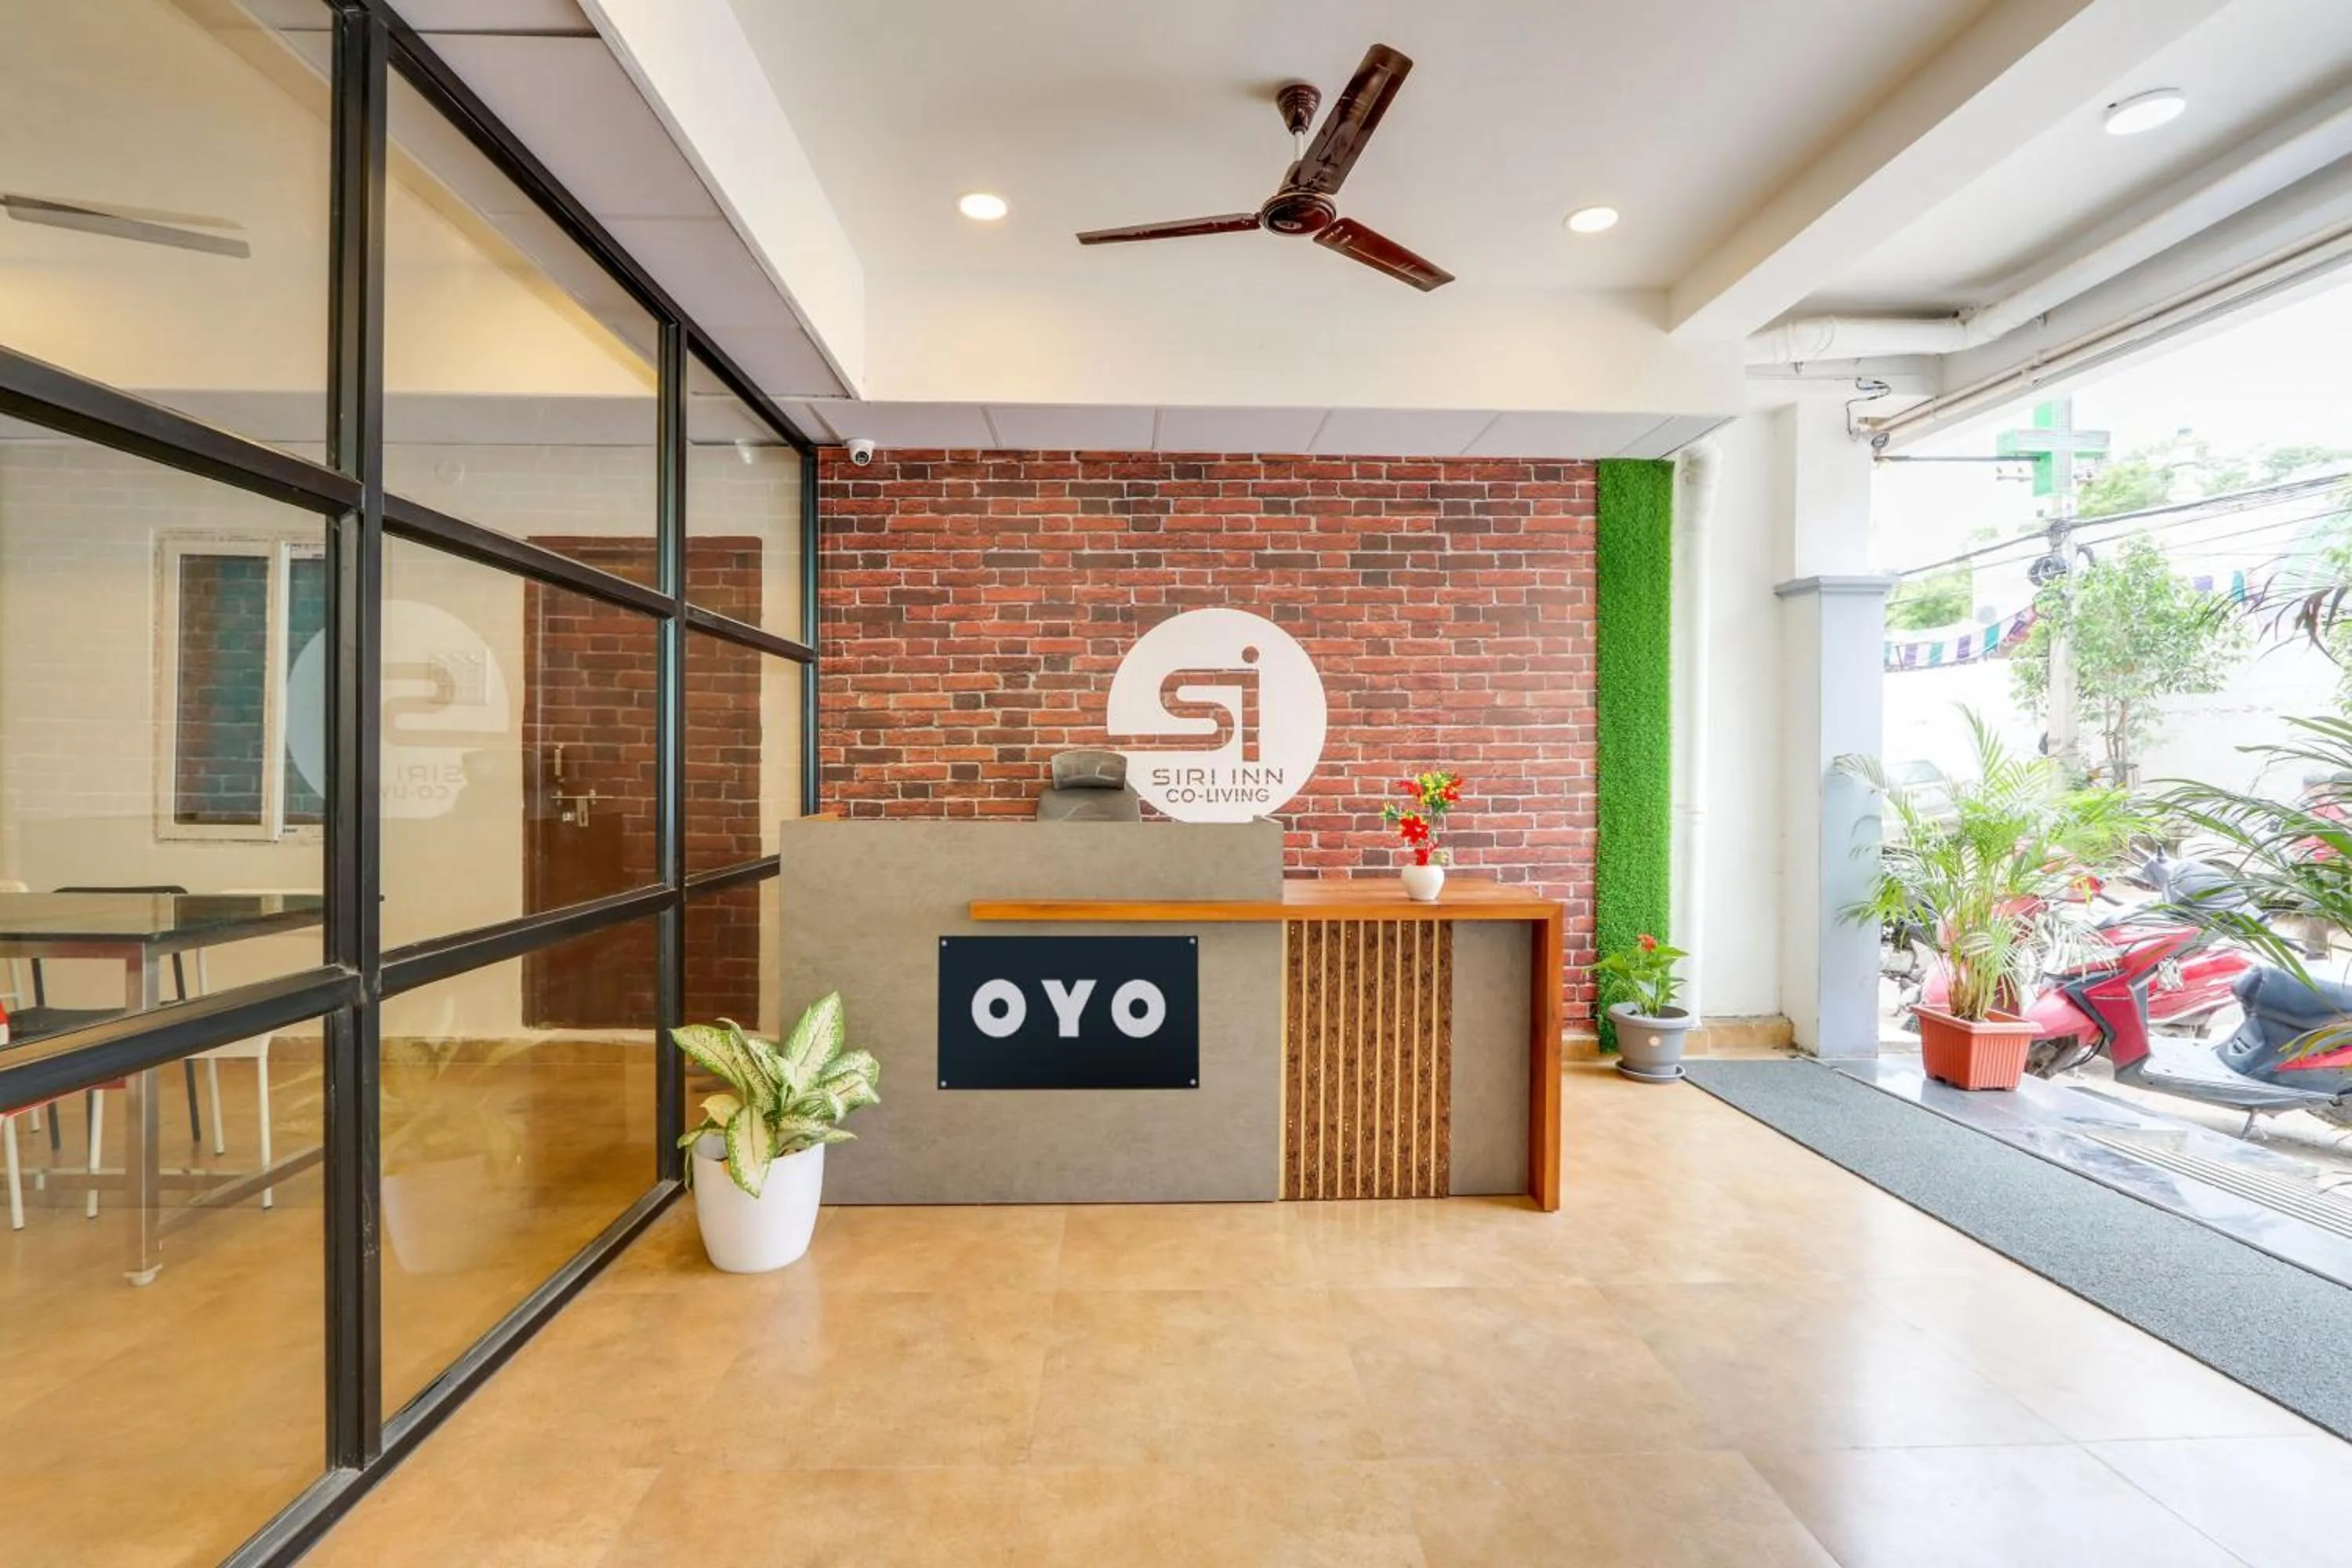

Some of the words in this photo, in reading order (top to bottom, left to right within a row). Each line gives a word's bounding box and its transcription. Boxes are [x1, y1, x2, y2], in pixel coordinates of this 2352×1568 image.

[1152, 768, 1215, 786] SIRI
[1232, 768, 1283, 786] INN
[1165, 787, 1271, 803] CO-LIVING
[971, 978, 1166, 1038] OYO
